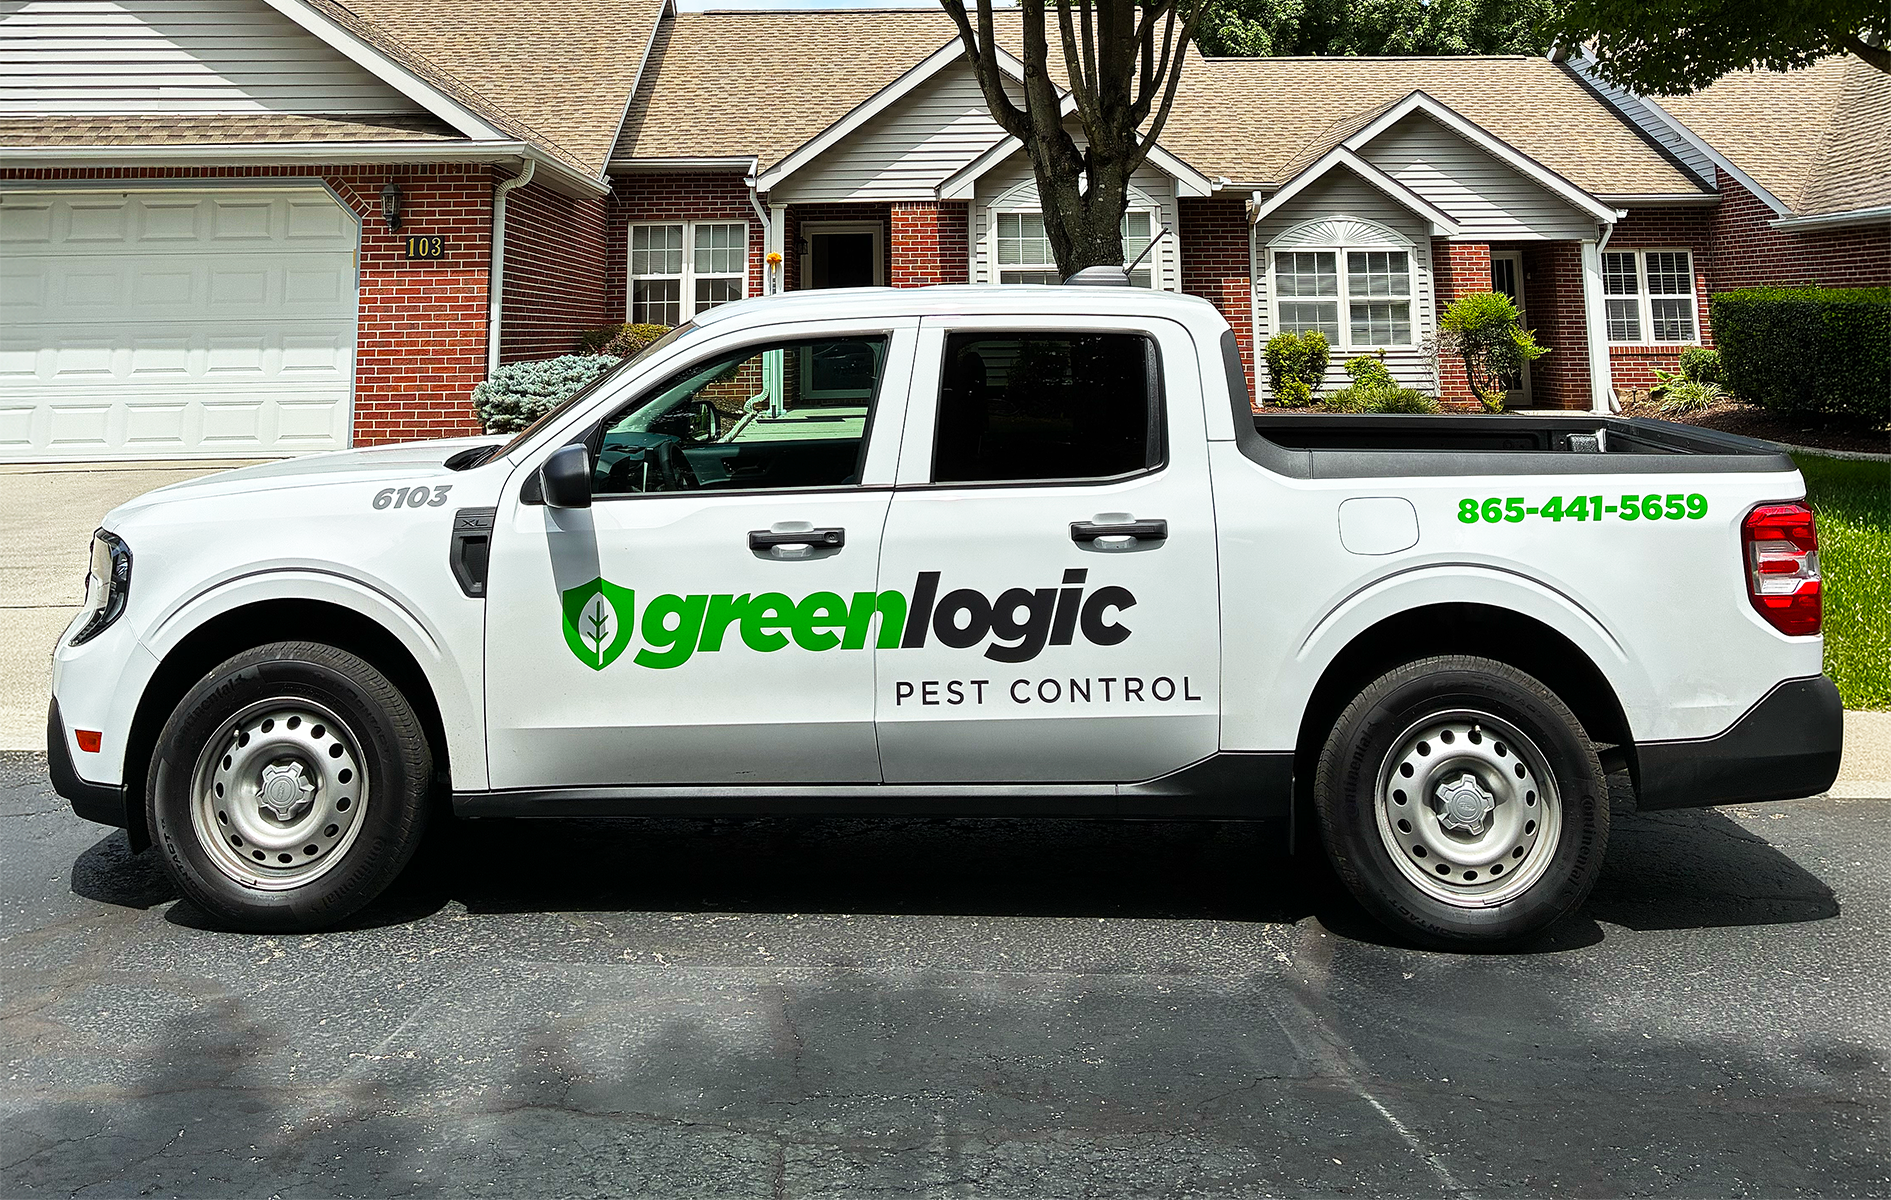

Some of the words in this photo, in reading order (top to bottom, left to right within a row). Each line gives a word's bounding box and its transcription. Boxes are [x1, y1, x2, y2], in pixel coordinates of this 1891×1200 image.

[409, 237, 441, 257] 103
[372, 484, 453, 510] 6103
[1457, 493, 1709, 523] 865-441-5659
[461, 519, 487, 527] XL
[633, 568, 1137, 669] greenlogic
[896, 680, 989, 705] PEST
[1010, 676, 1201, 704] CONTROL
